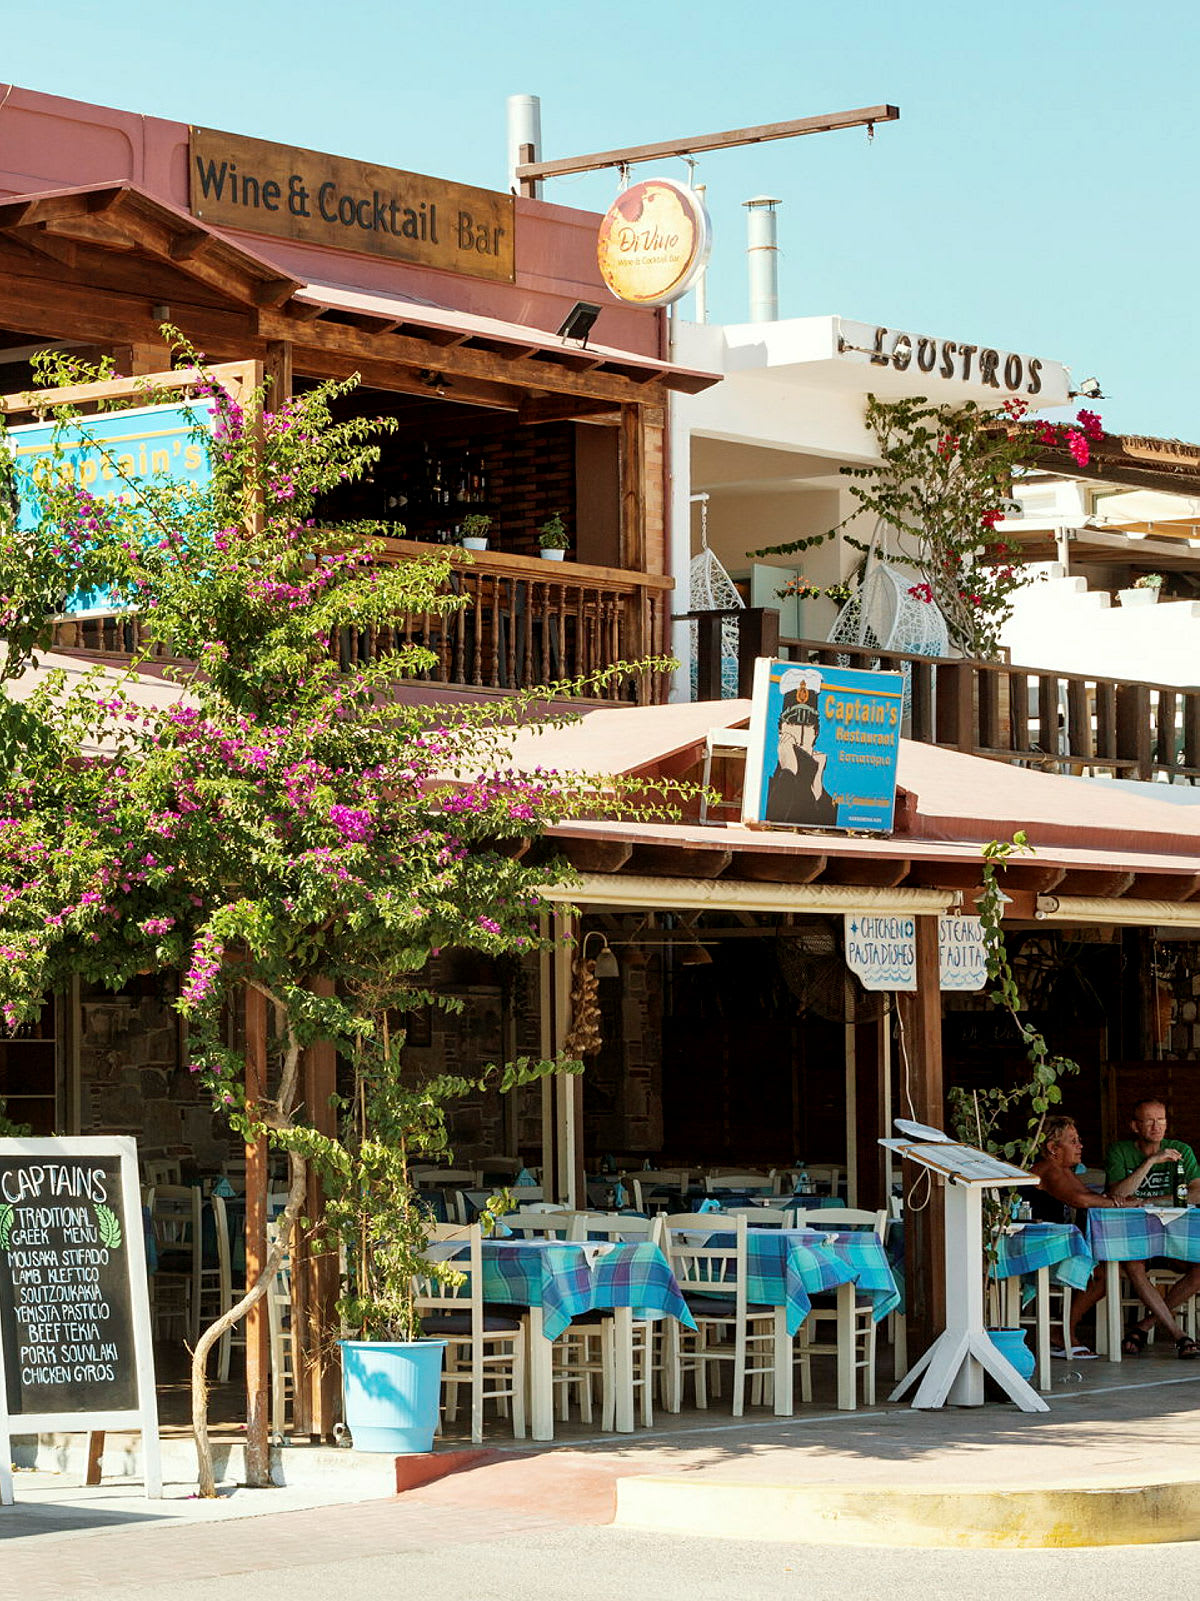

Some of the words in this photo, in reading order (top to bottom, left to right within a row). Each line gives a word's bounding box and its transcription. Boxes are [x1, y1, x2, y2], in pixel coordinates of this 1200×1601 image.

[196, 155, 282, 212] Wine
[288, 174, 312, 218] &
[317, 181, 440, 245] Cocktail
[457, 210, 506, 257] Bar
[825, 694, 898, 726] Captain's
[836, 726, 895, 747] Restaurant
[860, 917, 904, 939] CHICKEN
[939, 919, 982, 942] STEAKS
[1, 1164, 108, 1204] CAPTAINS
[15, 1206, 94, 1229] TRADITIONAL
[11, 1228, 50, 1246] GREEK
[63, 1227, 98, 1244] MENU
[7, 1250, 59, 1269] MOUSAKA
[61, 1248, 109, 1266] STIFADO
[11, 1268, 42, 1285] LAMB
[47, 1267, 100, 1284] KLEFTICO
[20, 1284, 103, 1304] SOUTZOUKAKIA
[13, 1304, 61, 1323] YEMISTA
[61, 1302, 111, 1321] PASTICIO
[28, 1322, 101, 1343] BEEFTEKIA
[20, 1345, 57, 1364] PORK
[61, 1342, 119, 1363] SOUVLAKI
[22, 1366, 72, 1385] CHICKEN
[73, 1364, 116, 1382] GYROS
